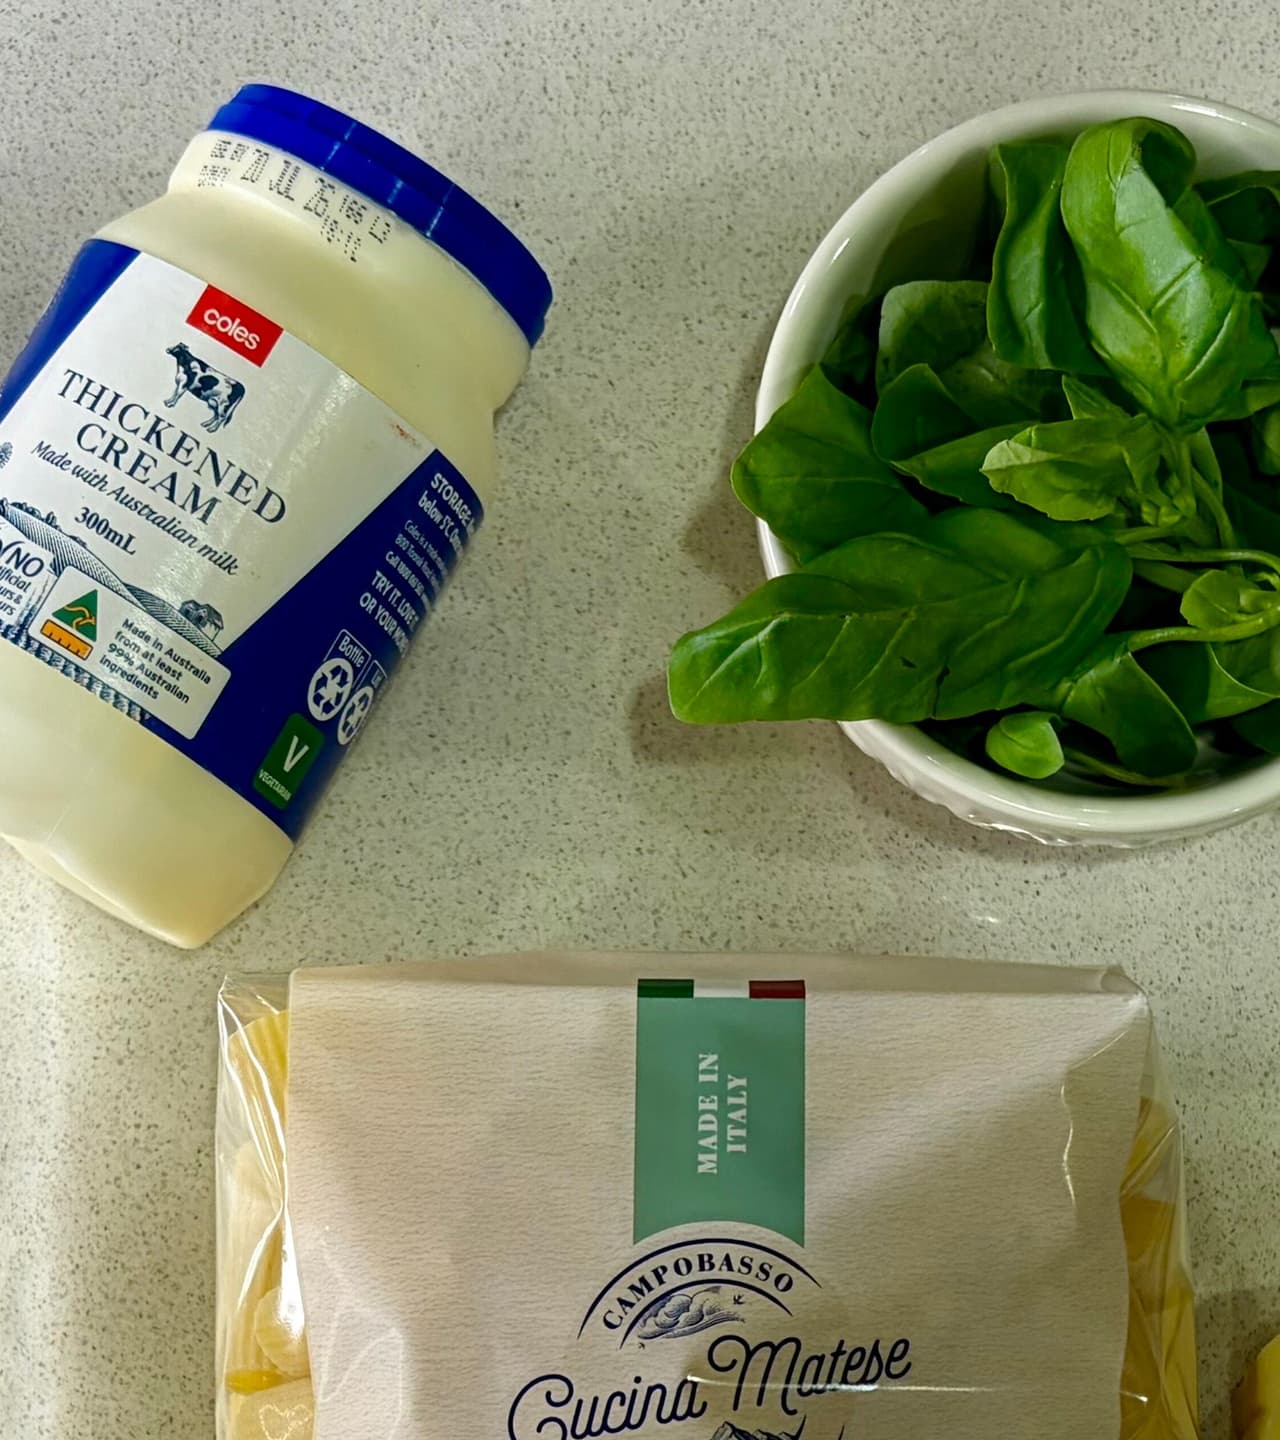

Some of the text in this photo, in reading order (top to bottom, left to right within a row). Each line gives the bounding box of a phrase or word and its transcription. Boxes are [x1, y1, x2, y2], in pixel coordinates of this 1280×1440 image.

[240, 147, 270, 183] 20
[303, 176, 337, 218] 26
[203, 304, 261, 350] coles
[58, 368, 287, 525] THICKENED
[76, 422, 223, 526] CREAM
[30, 440, 241, 576] Made with Australian milk
[73, 506, 137, 556] 300mL
[417, 490, 444, 524] below
[4, 546, 45, 577] NO
[371, 570, 392, 596] TRY
[359, 591, 374, 615] OR
[374, 603, 397, 637] YOUR
[107, 642, 191, 705] 99% Australian
[114, 630, 183, 681] from at least
[121, 618, 212, 684] Made in Australia
[338, 635, 365, 668] Bottle
[99, 654, 160, 700] ingredients
[282, 735, 310, 773] V
[258, 768, 293, 802] VEGETARIAN
[696, 1053, 720, 1174] MADE IN
[726, 1073, 748, 1153] ITALY
[601, 1252, 795, 1332] CAMPOBASSO
[706, 1333, 913, 1416] Matese
